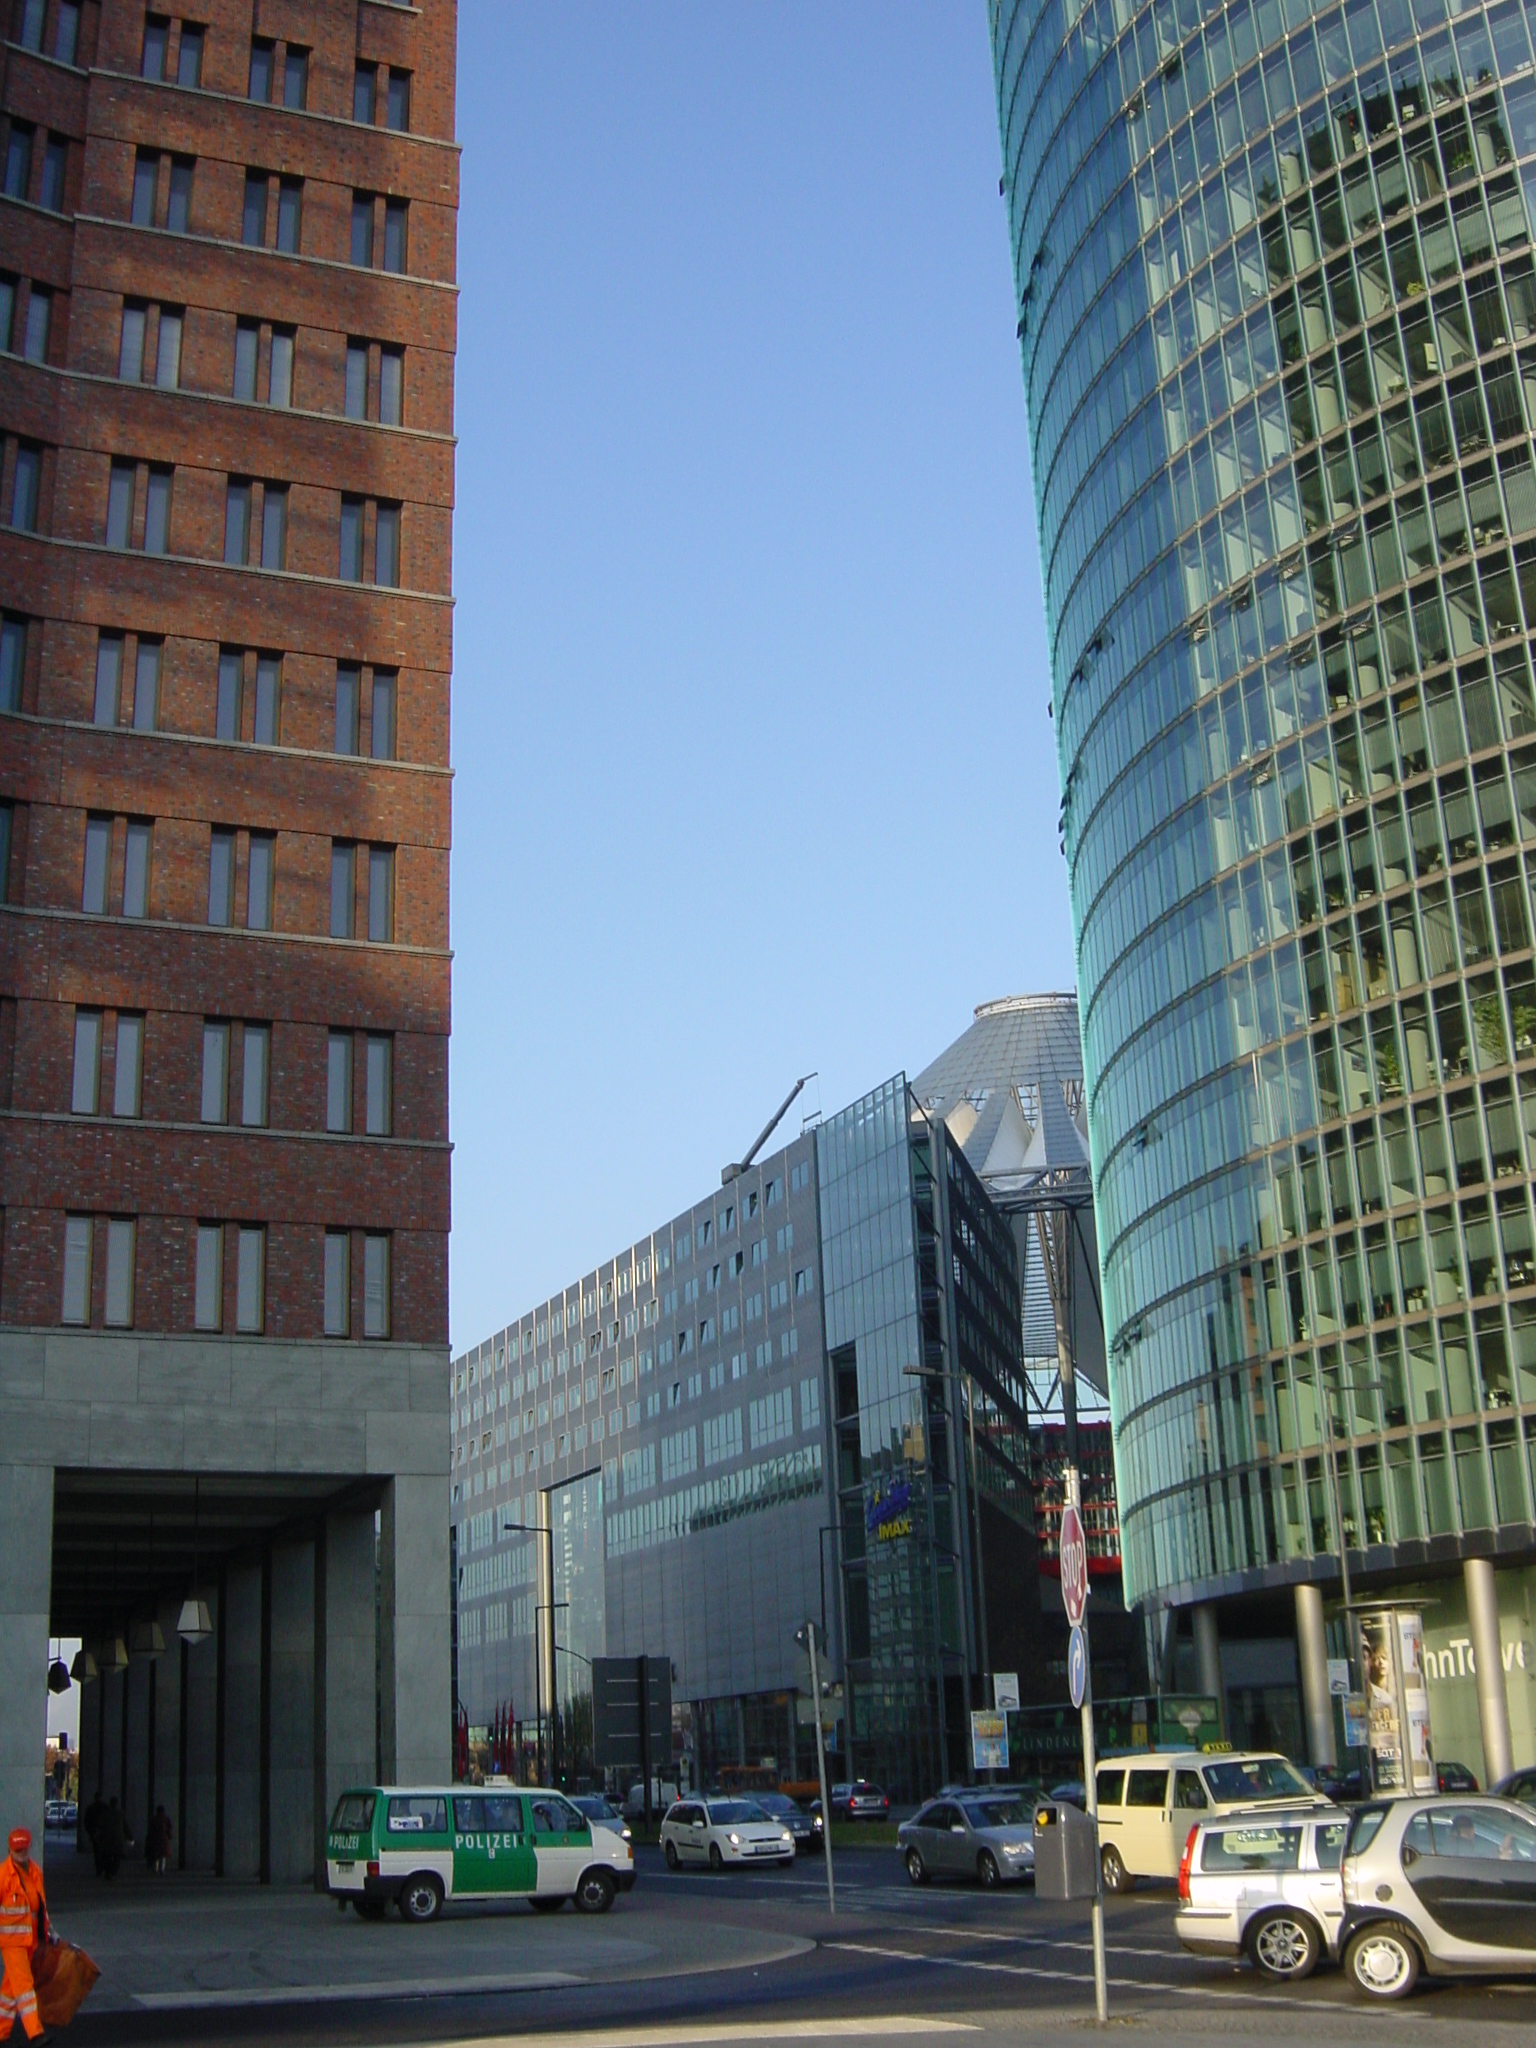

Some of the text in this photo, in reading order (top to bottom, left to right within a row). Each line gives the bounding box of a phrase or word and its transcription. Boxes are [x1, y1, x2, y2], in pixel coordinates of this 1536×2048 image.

[878, 1518, 911, 1541] IMAX
[1062, 1540, 1083, 1589] STOP
[333, 1834, 360, 1850] POLIZEI
[455, 1833, 518, 1849] POLIZEI
